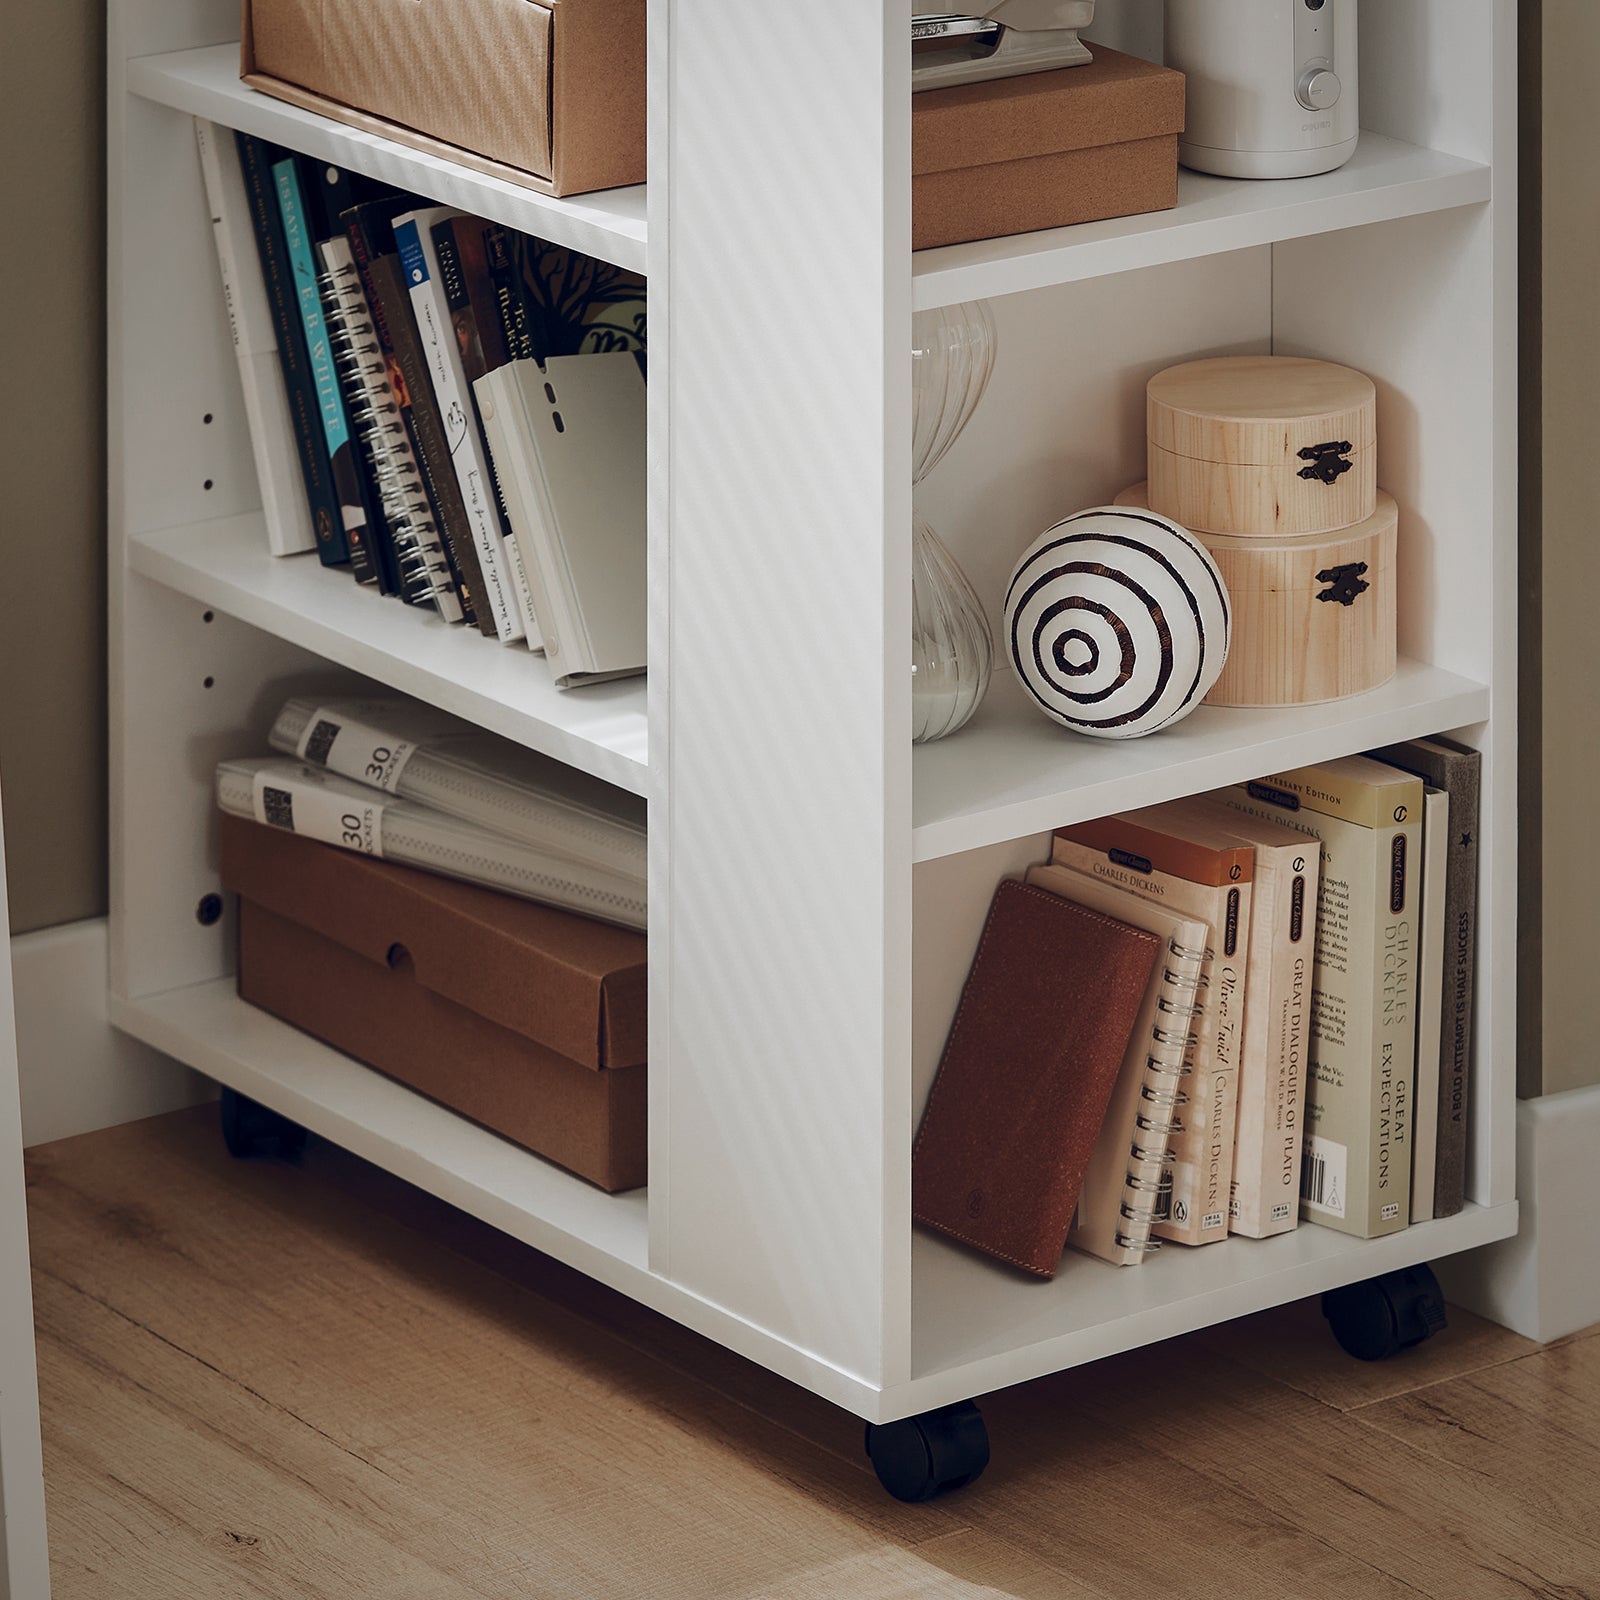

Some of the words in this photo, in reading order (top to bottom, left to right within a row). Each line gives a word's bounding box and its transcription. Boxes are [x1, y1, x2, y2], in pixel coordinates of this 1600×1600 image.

[348, 223, 368, 266] KATE
[279, 175, 300, 249] ESSAYS
[297, 260, 310, 277] of
[313, 339, 341, 434] WHITE
[519, 333, 533, 358] Ki
[364, 746, 391, 781] 30
[341, 813, 363, 848] 30
[1275, 817, 1321, 840] DICKENS
[1396, 837, 1405, 868] Signet
[1093, 862, 1129, 883] CHARLES
[1129, 875, 1165, 896] DICKENS
[1294, 878, 1303, 904] Signet
[1392, 870, 1404, 912] Classics
[1229, 889, 1238, 917] Signet
[1291, 904, 1302, 941] Classics
[1226, 917, 1237, 955] Classics
[1457, 910, 1469, 969] SUCCESS
[1219, 966, 1237, 1017] Oliver
[1292, 958, 1304, 1010] GREAT
[1383, 925, 1397, 1027] DICKENS
[1396, 921, 1409, 1025] CHARLES
[1456, 969, 1467, 1004] HALF
[1456, 1004, 1465, 1015] IS
[1216, 1020, 1235, 1065] Twist
[1286, 1018, 1300, 1106] DIALOGUES
[1453, 1015, 1465, 1076] ATTEMPT
[1213, 1075, 1228, 1140] CHARLES
[1395, 1080, 1406, 1144] GREAT
[1453, 1077, 1463, 1110] BOLD
[1284, 1109, 1296, 1130] OF
[1379, 1042, 1393, 1190] EXPECTATIONS
[1452, 1110, 1462, 1122] A
[1208, 1143, 1221, 1209] DICKENS
[1281, 1135, 1294, 1186] PLATO
